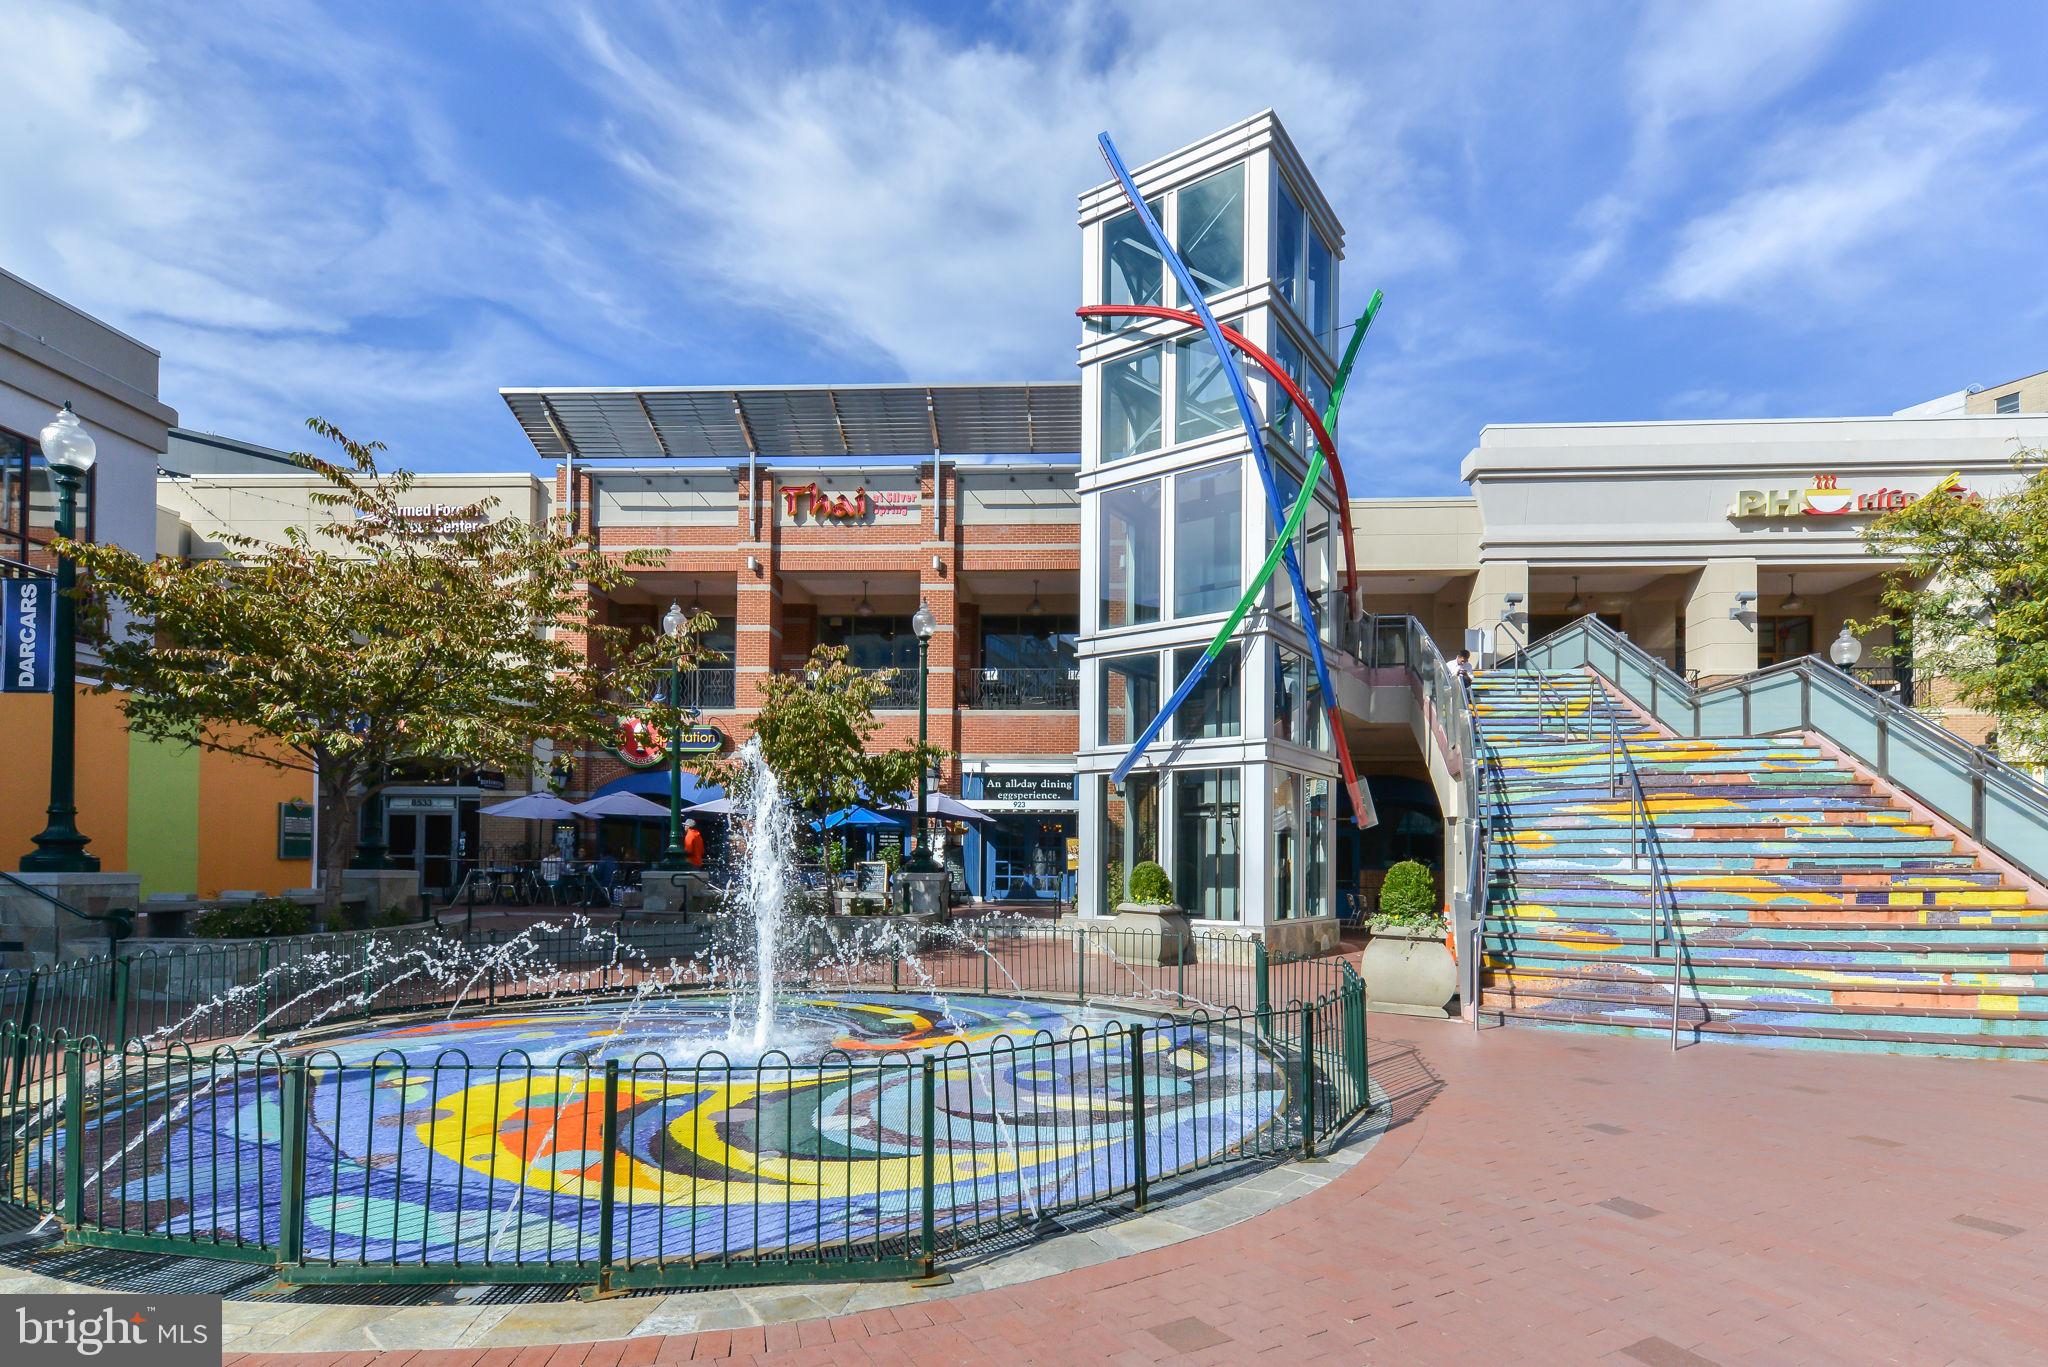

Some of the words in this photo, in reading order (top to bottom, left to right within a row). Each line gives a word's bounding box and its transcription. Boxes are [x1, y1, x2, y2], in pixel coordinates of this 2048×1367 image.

[778, 482, 865, 518] Thai
[886, 492, 918, 503] Silver
[387, 503, 431, 517] rmed
[435, 503, 478, 517] Forc
[18, 583, 38, 687] DARCARS
[986, 779, 1002, 788] An
[1040, 779, 1072, 791] dining
[997, 790, 1061, 801] eggsperience.
